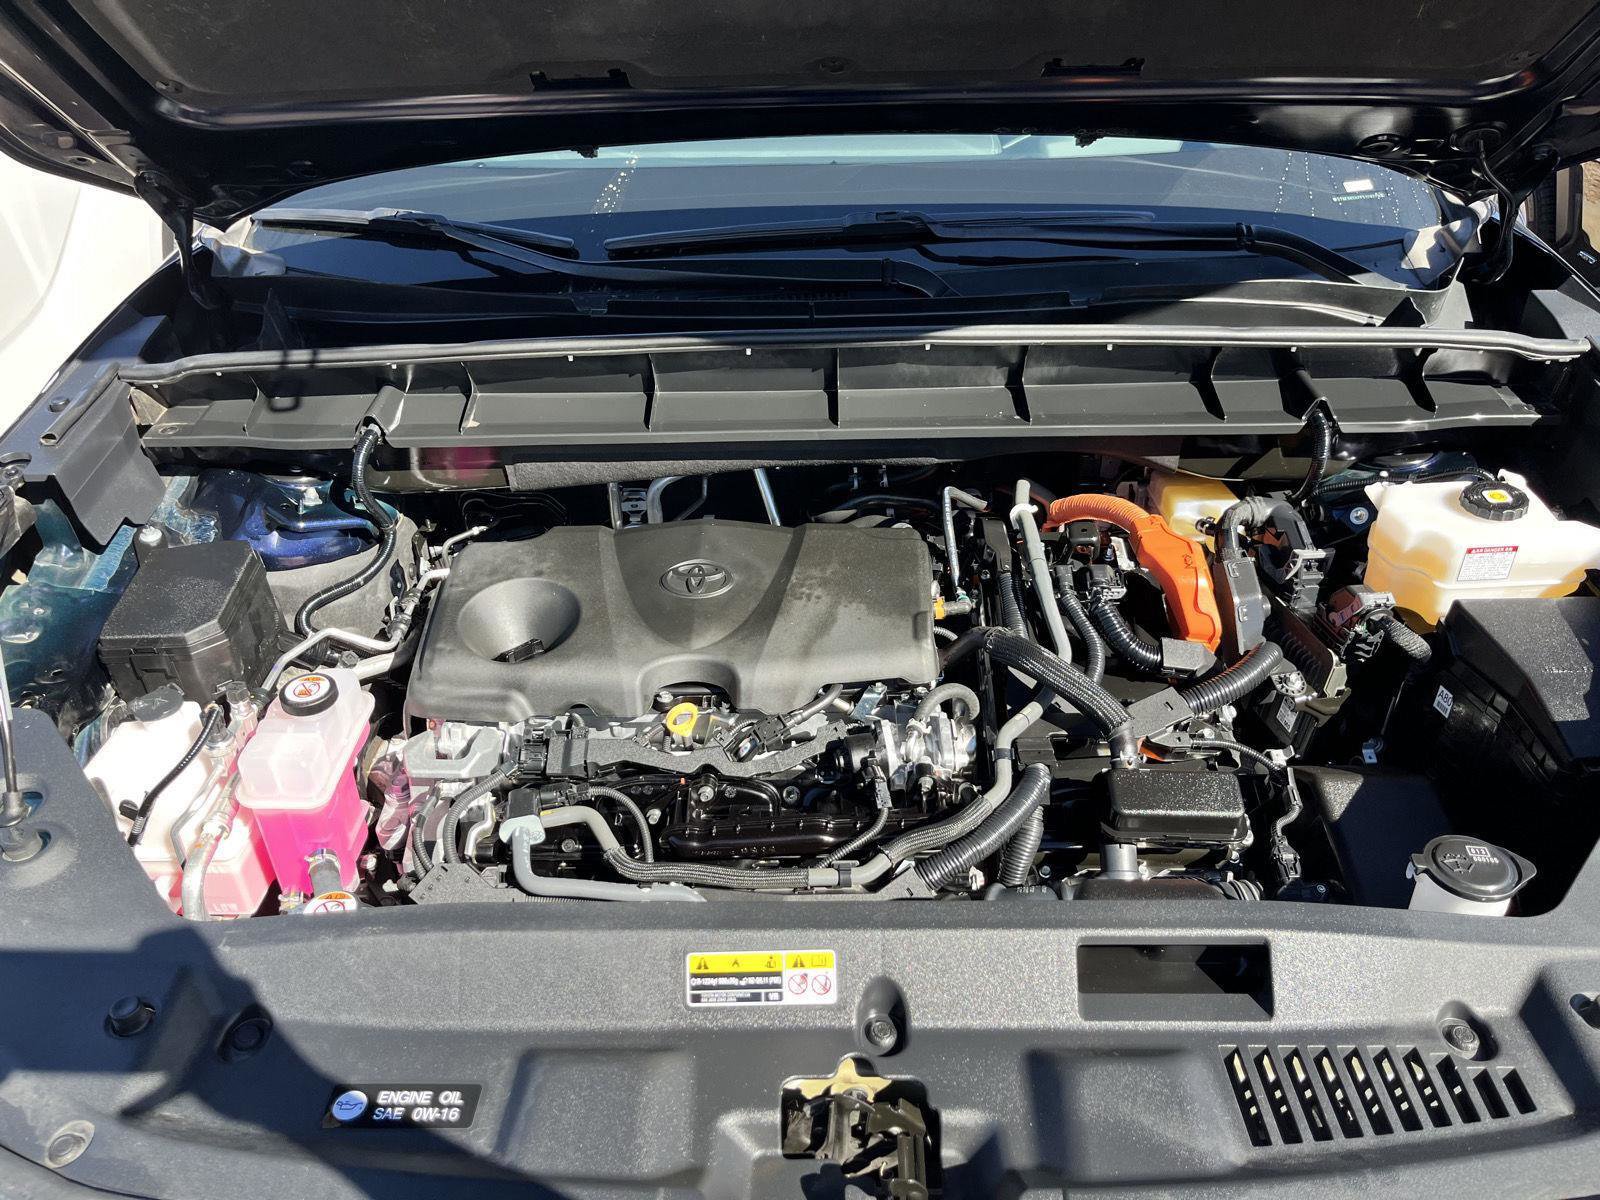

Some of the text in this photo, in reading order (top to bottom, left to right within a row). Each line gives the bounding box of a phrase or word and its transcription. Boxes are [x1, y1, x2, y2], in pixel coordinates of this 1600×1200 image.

[212, 903, 238, 912] LOW
[376, 1090, 465, 1105] ENGINE OIL
[373, 1107, 460, 1121] SAE 0W-16
